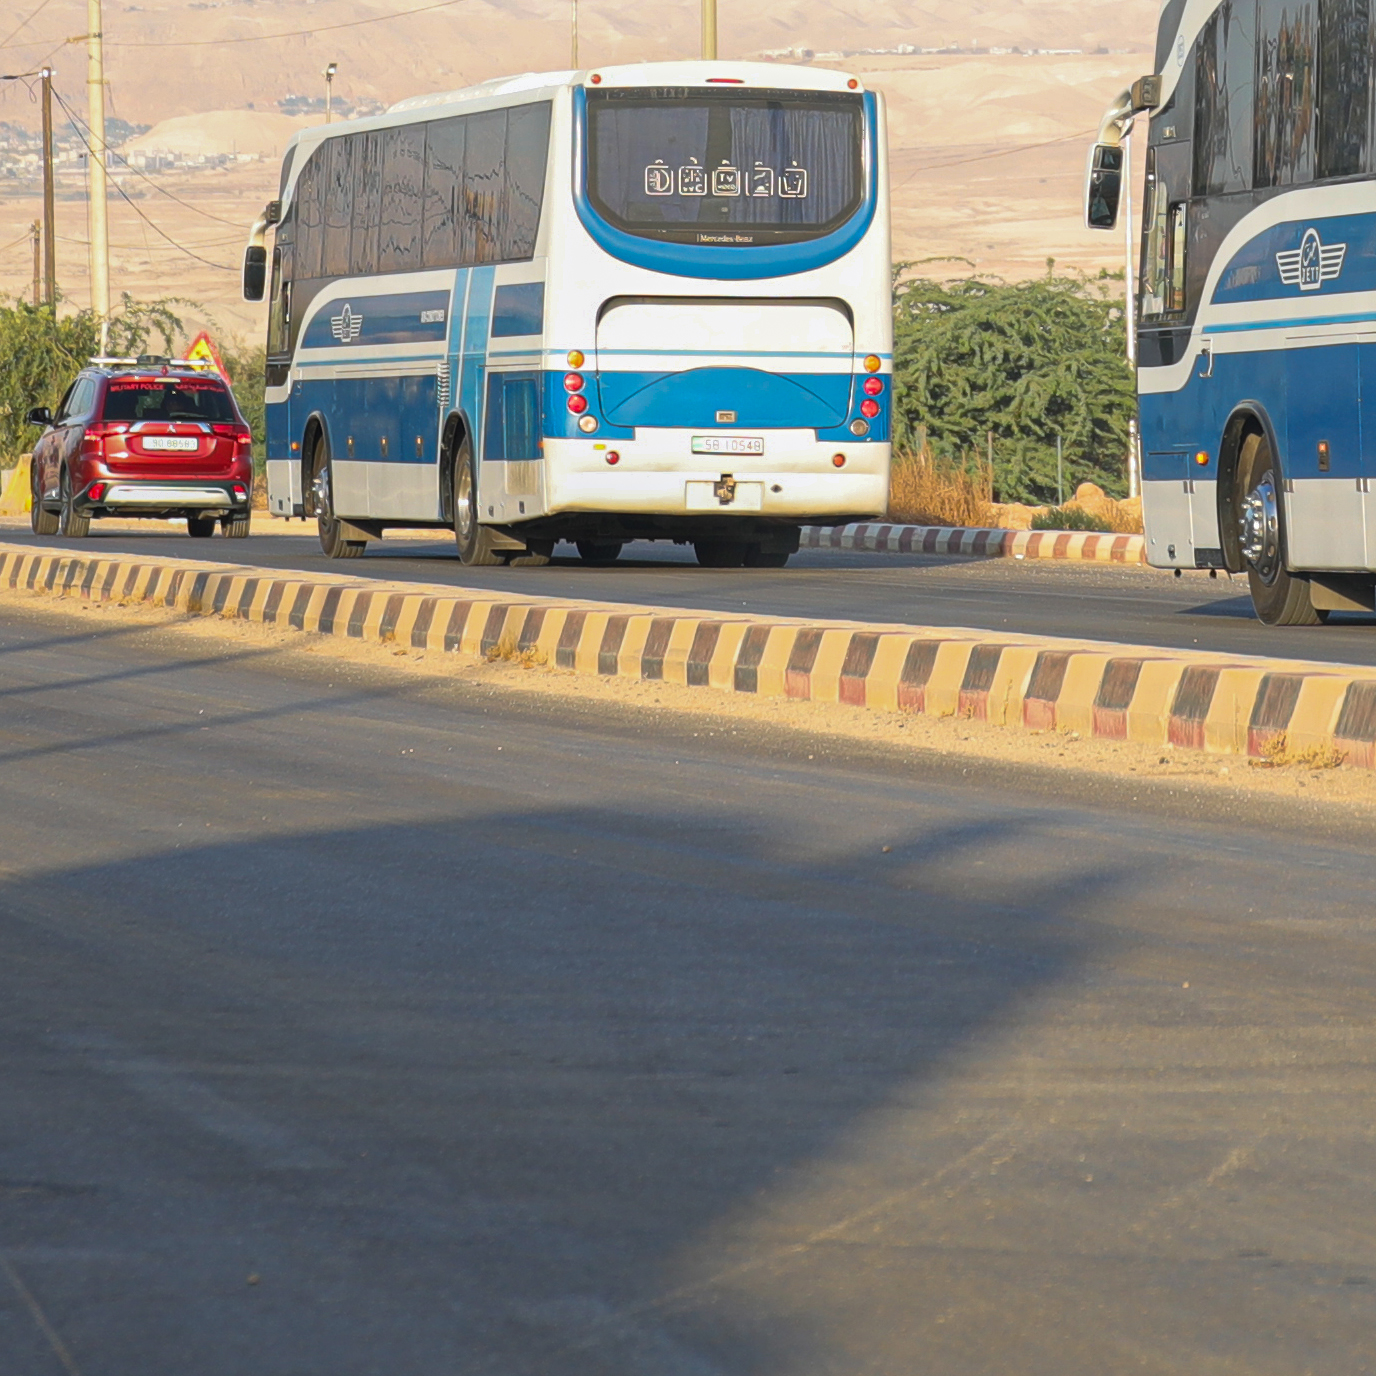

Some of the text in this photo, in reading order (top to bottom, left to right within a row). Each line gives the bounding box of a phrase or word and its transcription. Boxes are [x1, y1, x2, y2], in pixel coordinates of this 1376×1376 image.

[719, 173, 734, 183] TV
[1302, 266, 1319, 283] JETT
[140, 383, 166, 391] POLICE
